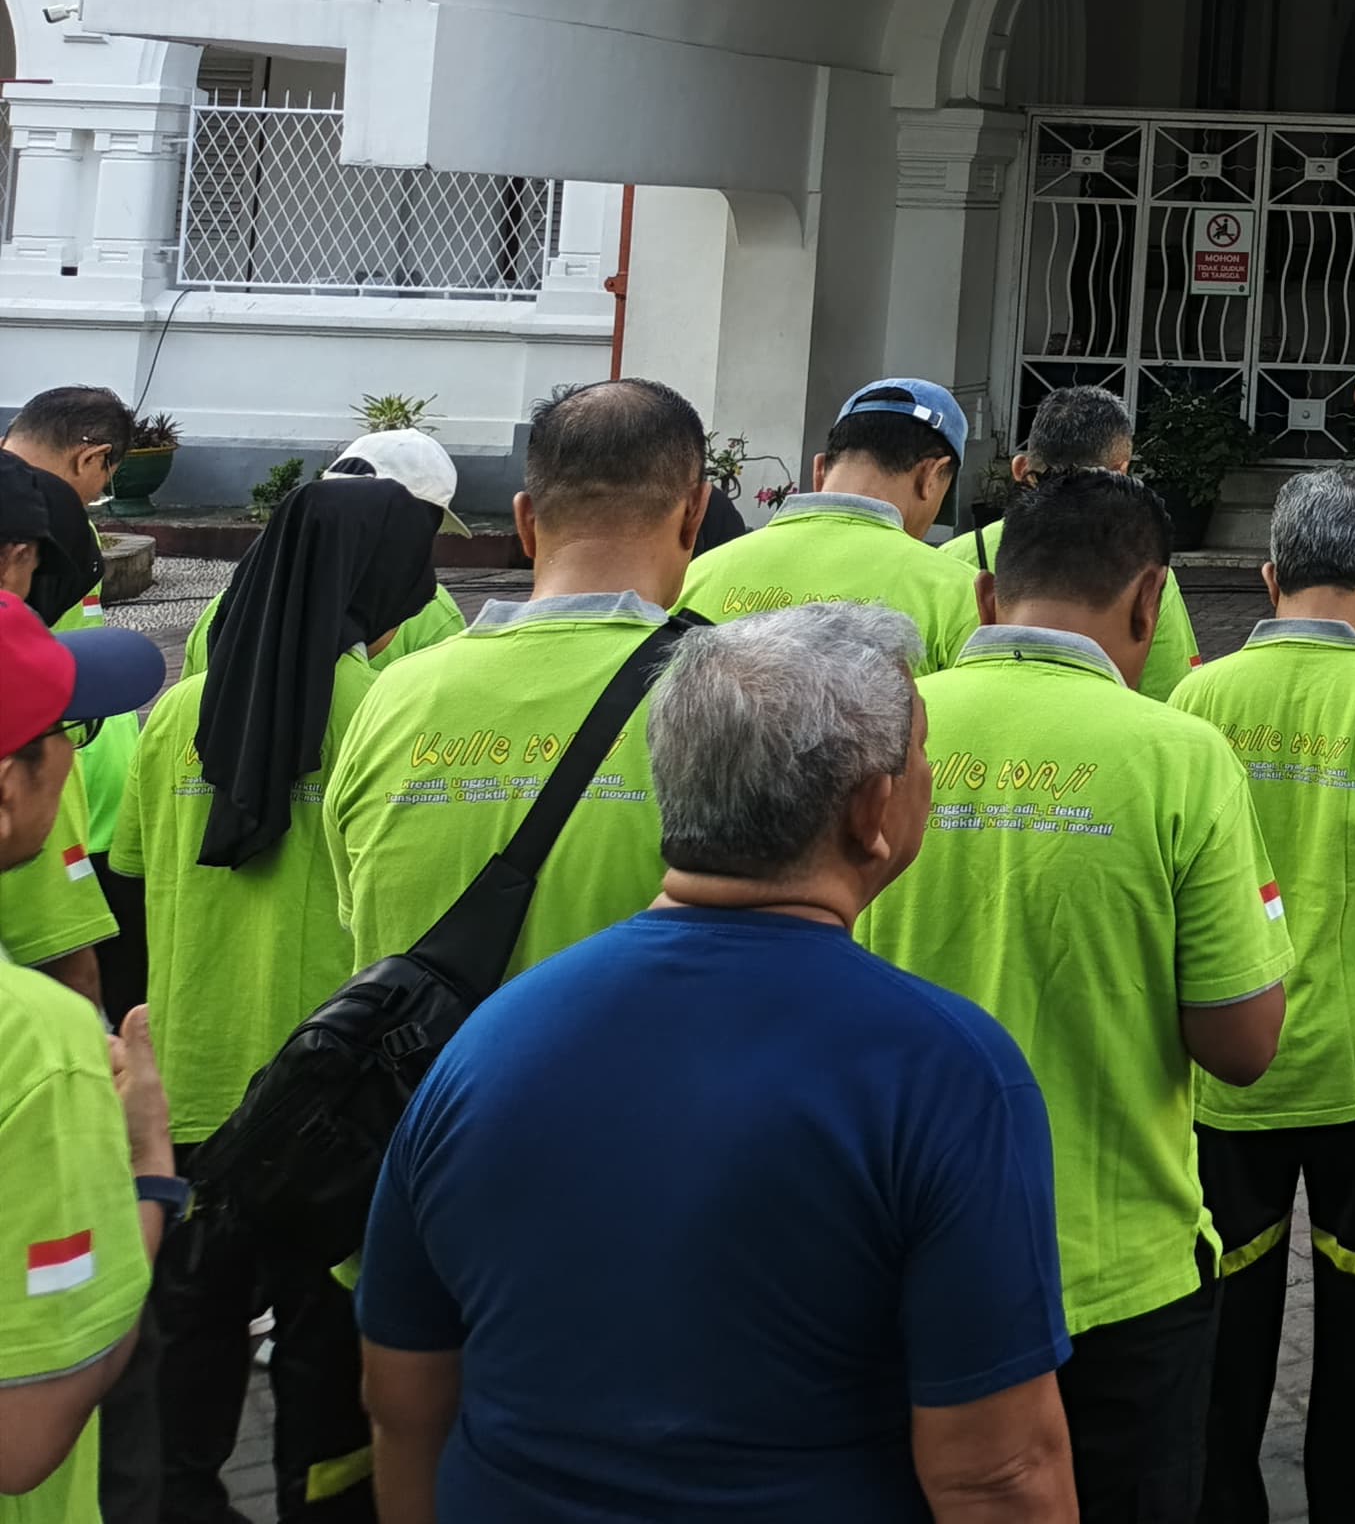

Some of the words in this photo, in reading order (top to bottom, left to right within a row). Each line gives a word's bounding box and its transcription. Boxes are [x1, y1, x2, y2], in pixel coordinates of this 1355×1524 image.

[1205, 255, 1240, 263] MOHON
[722, 587, 793, 614] Kulle
[411, 730, 511, 767] Kulle
[401, 778, 447, 791] Kreatif,
[590, 775, 625, 787] ektif,
[929, 752, 988, 790] ulle
[996, 759, 1098, 800] tonji
[456, 789, 509, 804] Objektif,
[595, 788, 647, 801] Inovatif
[1047, 805, 1094, 819] Efektif,
[1063, 821, 1113, 837] Inovatif
